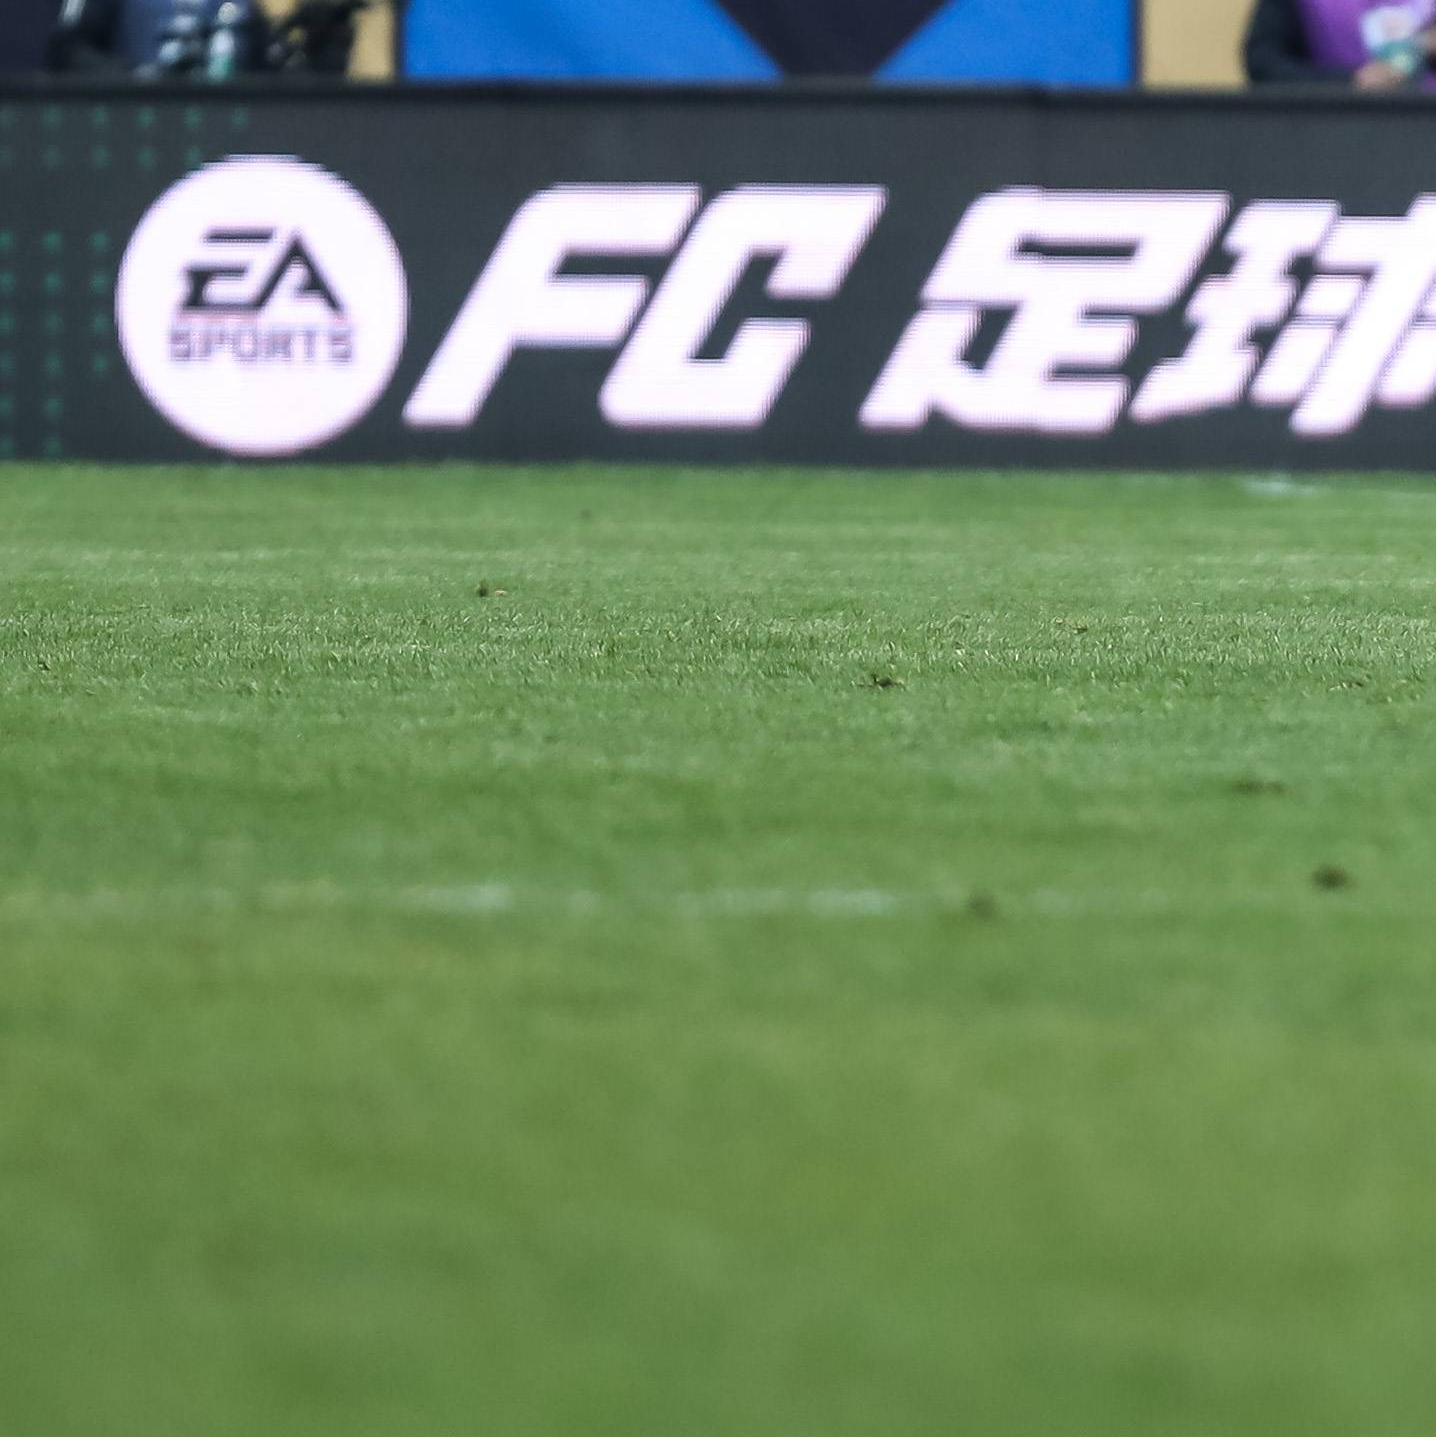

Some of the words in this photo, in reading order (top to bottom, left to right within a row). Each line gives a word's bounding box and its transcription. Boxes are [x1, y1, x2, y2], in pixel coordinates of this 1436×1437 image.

[182, 228, 344, 312] EA
[403, 181, 885, 429] FC
[168, 326, 354, 362] SPORTS
